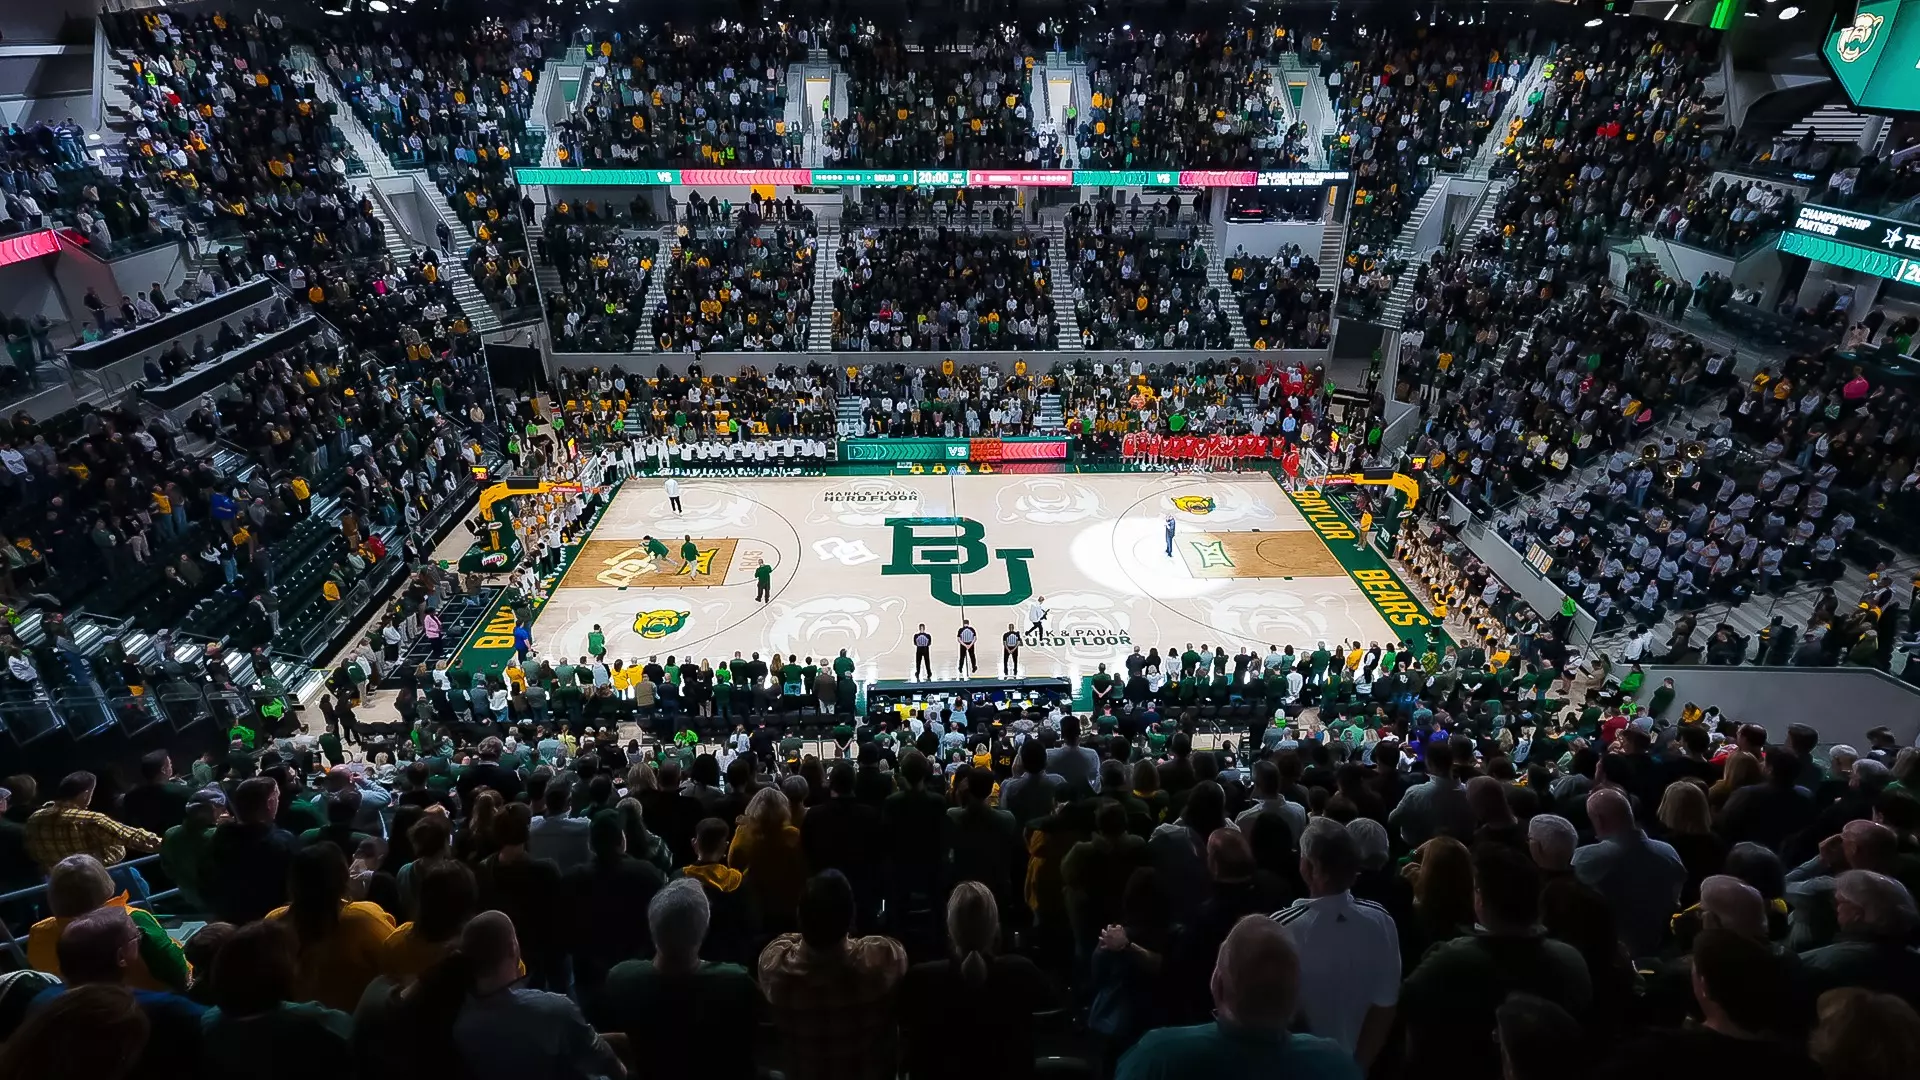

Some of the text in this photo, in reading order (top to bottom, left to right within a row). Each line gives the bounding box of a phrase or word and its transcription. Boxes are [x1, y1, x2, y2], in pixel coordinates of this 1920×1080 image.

[657, 172, 672, 183] VS
[919, 172, 948, 183] 20:00
[1156, 173, 1171, 184] VS
[1800, 208, 1871, 230] CHAMPIONSHIP
[1795, 218, 1838, 236] PARTNER
[948, 447, 966, 457] VS
[1291, 490, 1356, 540] BAYLOR
[881, 517, 1034, 606] BU
[1353, 569, 1429, 626] BEARS
[1070, 636, 1132, 646] FLOOR
